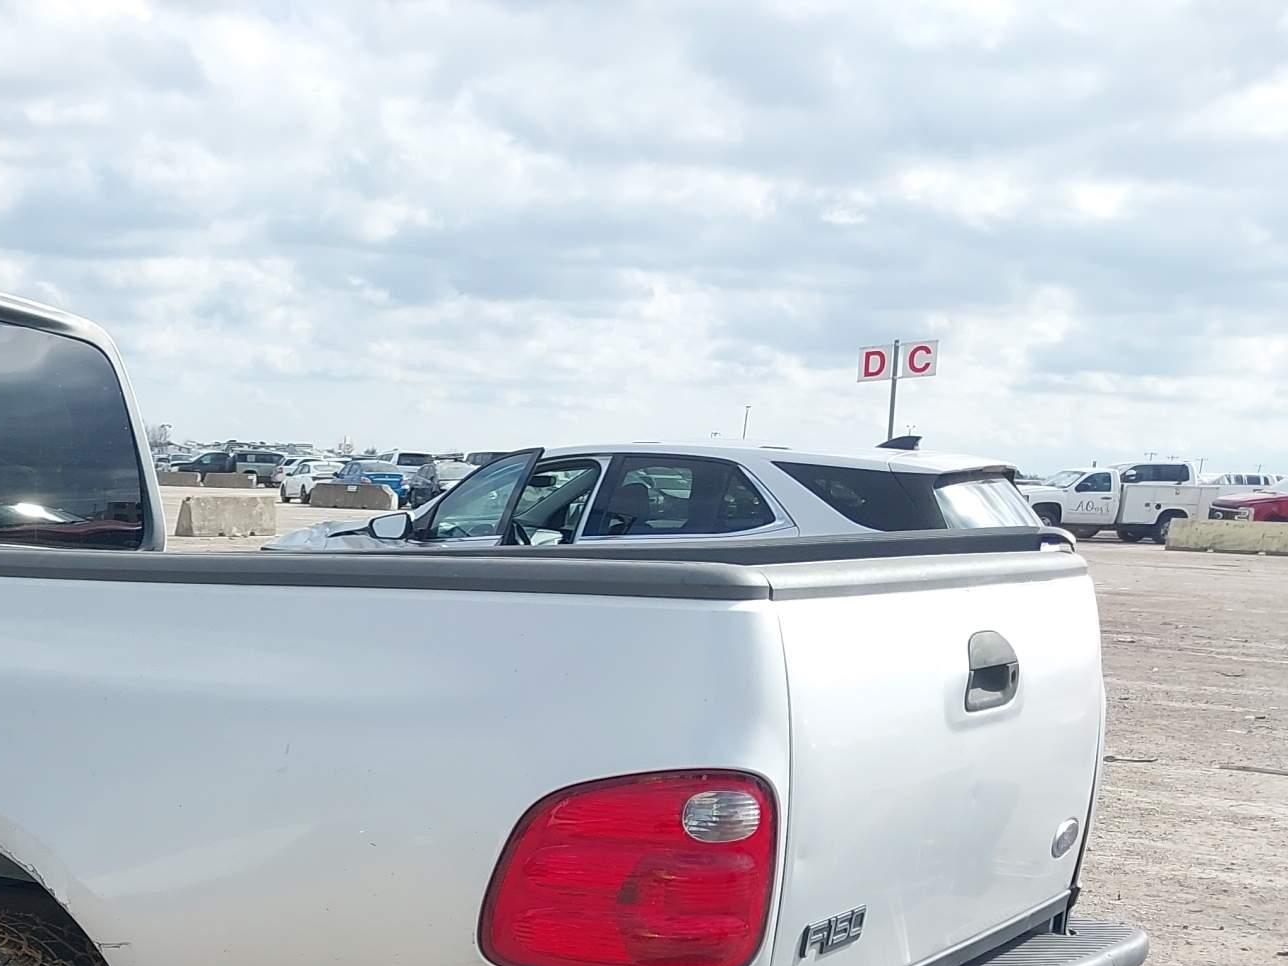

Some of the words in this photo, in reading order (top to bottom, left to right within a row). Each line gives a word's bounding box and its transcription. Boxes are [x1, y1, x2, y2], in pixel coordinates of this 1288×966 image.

[863, 350, 886, 377] D
[908, 345, 932, 374] C
[799, 905, 866, 958] F150
